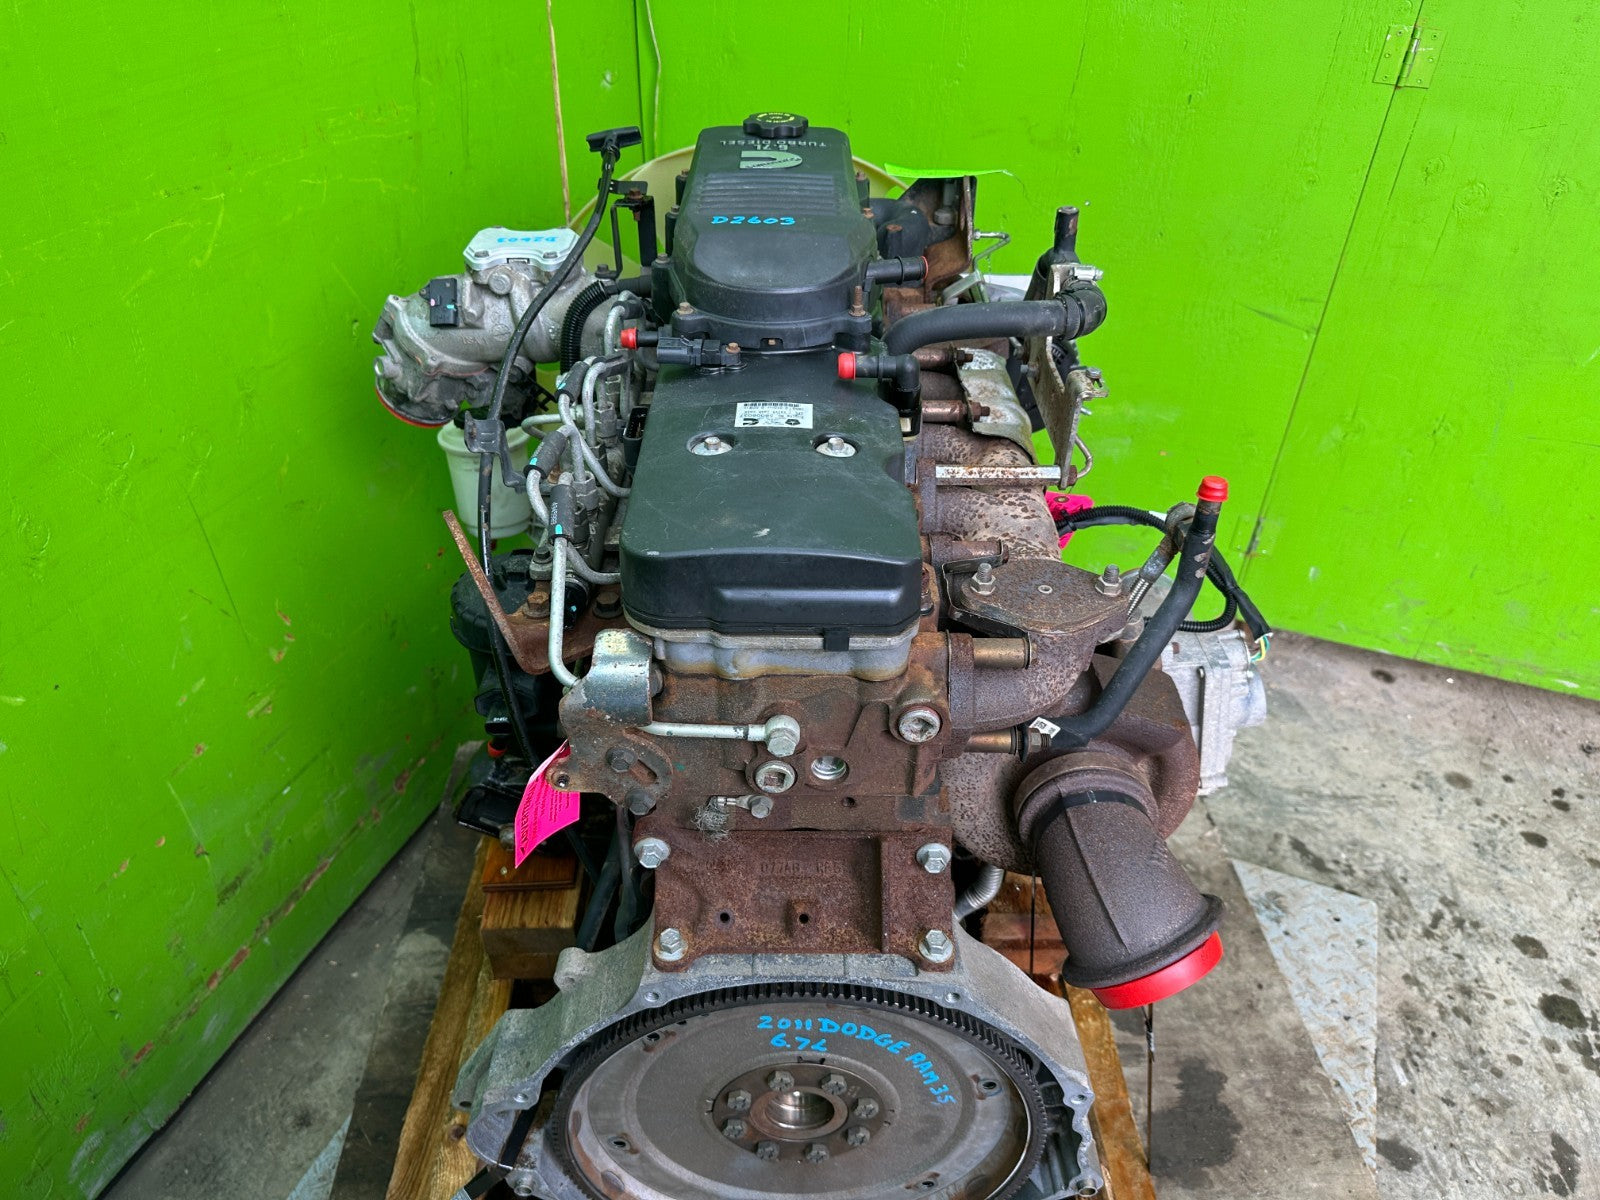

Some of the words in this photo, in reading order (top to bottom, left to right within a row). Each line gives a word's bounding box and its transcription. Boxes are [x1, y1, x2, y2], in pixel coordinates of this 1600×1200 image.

[754, 143, 788, 151] 6.7L
[711, 215, 796, 226] D2603
[770, 1033, 828, 1051] 6.7L
[757, 1015, 812, 1031] 2011
[817, 1017, 911, 1055] DODGE
[905, 1051, 940, 1085] RAM
